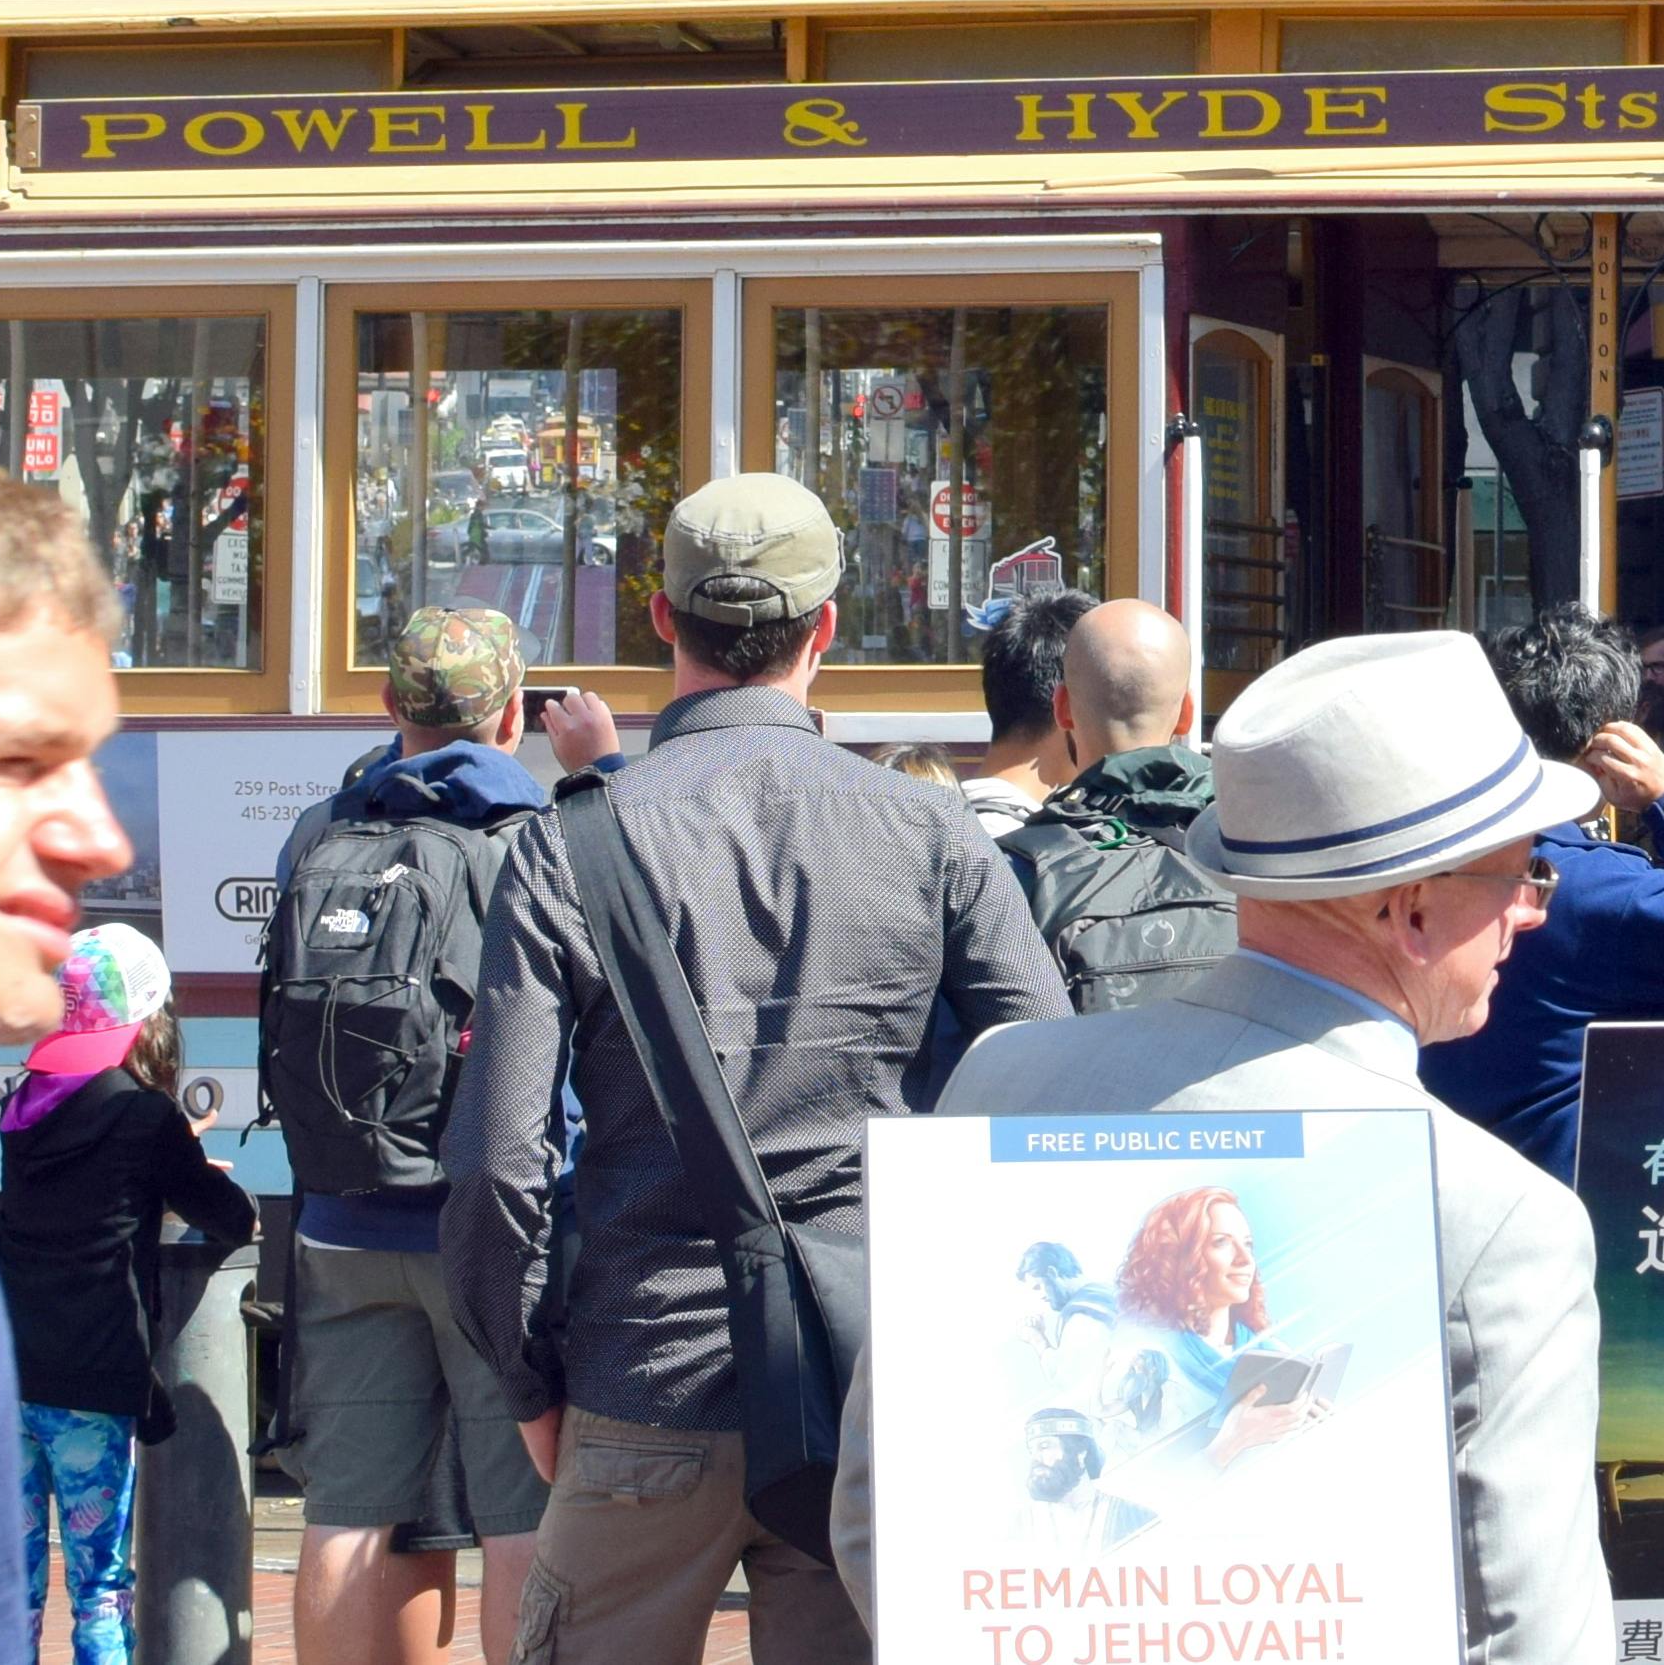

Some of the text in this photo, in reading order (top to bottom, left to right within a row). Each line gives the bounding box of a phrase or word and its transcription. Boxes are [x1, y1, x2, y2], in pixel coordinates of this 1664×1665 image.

[81, 102, 636, 159] POWELL
[783, 98, 867, 147] &
[1015, 86, 1387, 141] HYDE
[1598, 236, 1609, 383] HOLD ON
[26, 438, 53, 452] UNI
[25, 454, 54, 466] QLO
[234, 781, 338, 796] 259 Post Stre
[241, 806, 302, 821] 415-230
[235, 886, 278, 914] RIM
[1027, 1130, 1266, 1152] FREE PUBLIC EVENT
[963, 1563, 1364, 1610] REMAIN LOYAL
[982, 1619, 1345, 1665] TO JEHOVAH!
